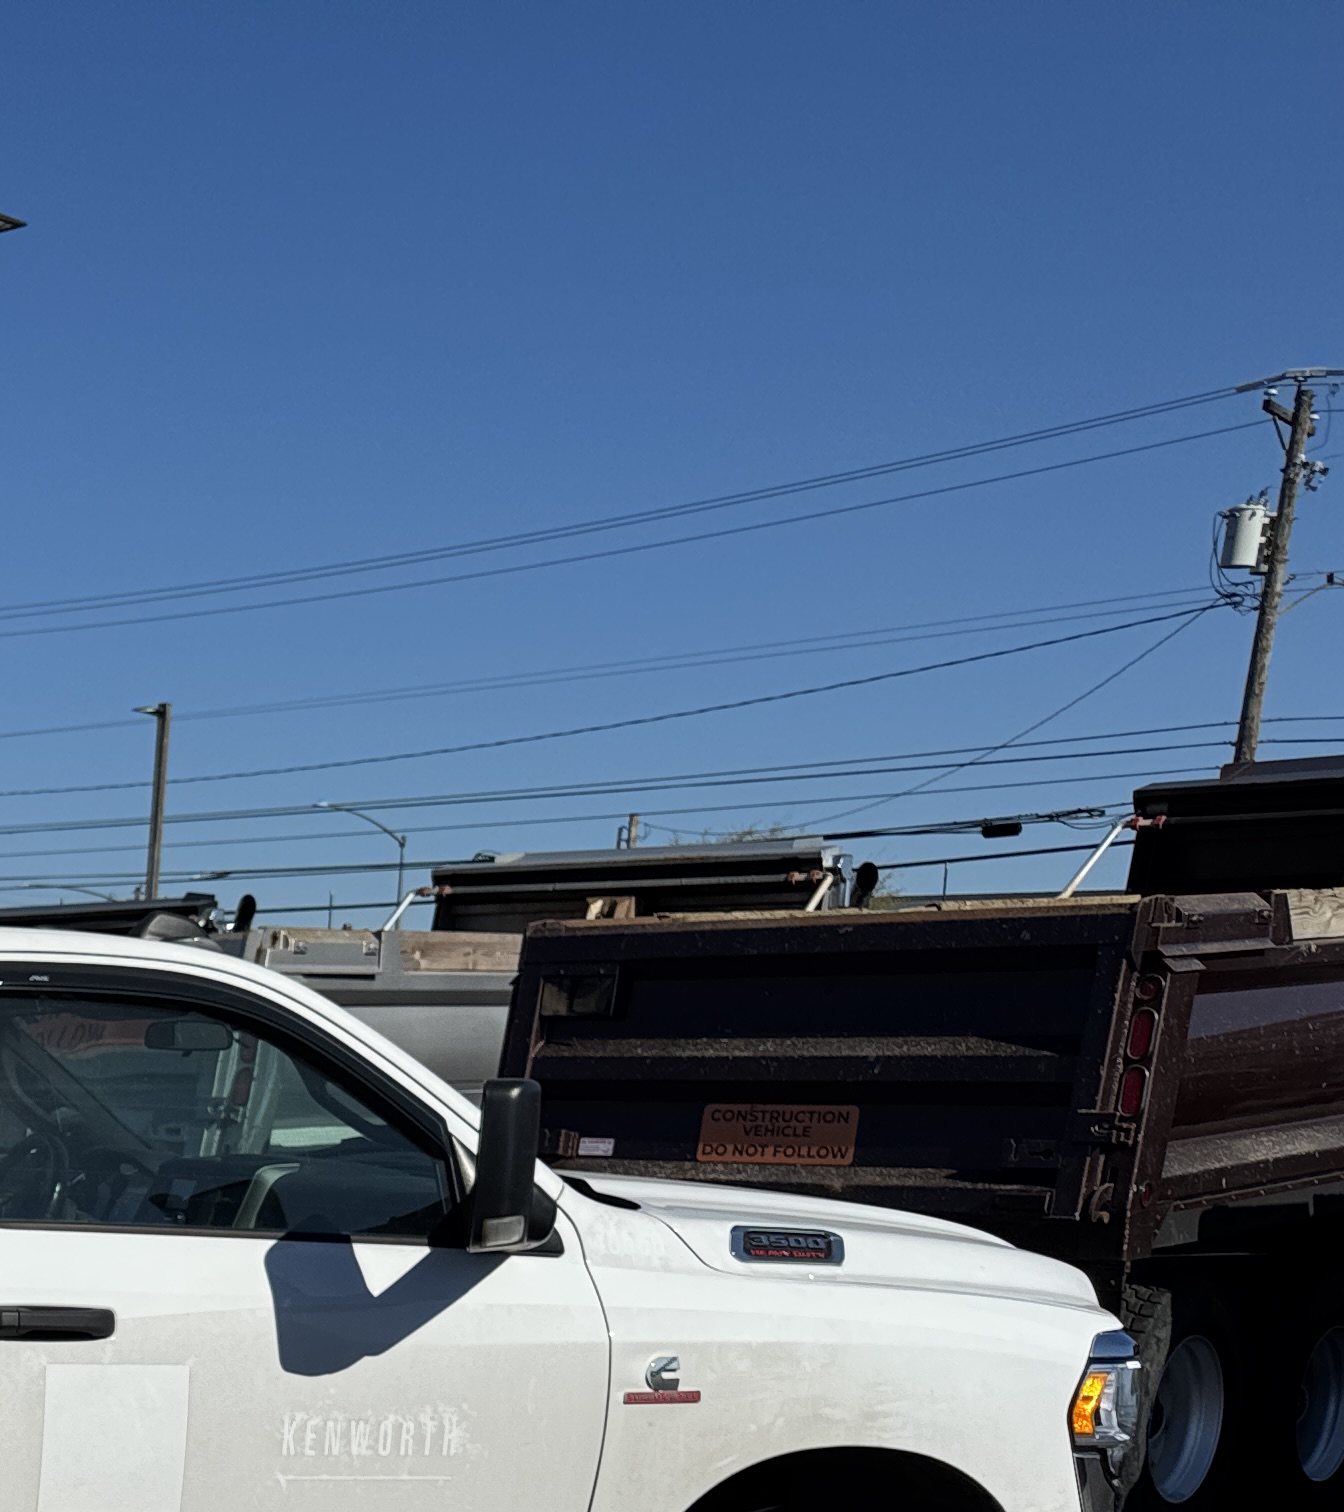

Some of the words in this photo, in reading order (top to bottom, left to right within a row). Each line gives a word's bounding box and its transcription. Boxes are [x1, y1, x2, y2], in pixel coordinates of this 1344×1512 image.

[711, 1109, 850, 1124] CONSTRUCTION
[743, 1123, 813, 1138] VEHICLE
[701, 1143, 727, 1156] DO
[732, 1144, 769, 1157] NOT
[772, 1145, 849, 1159] FOLLOW
[280, 1412, 459, 1457] KENWORTH
